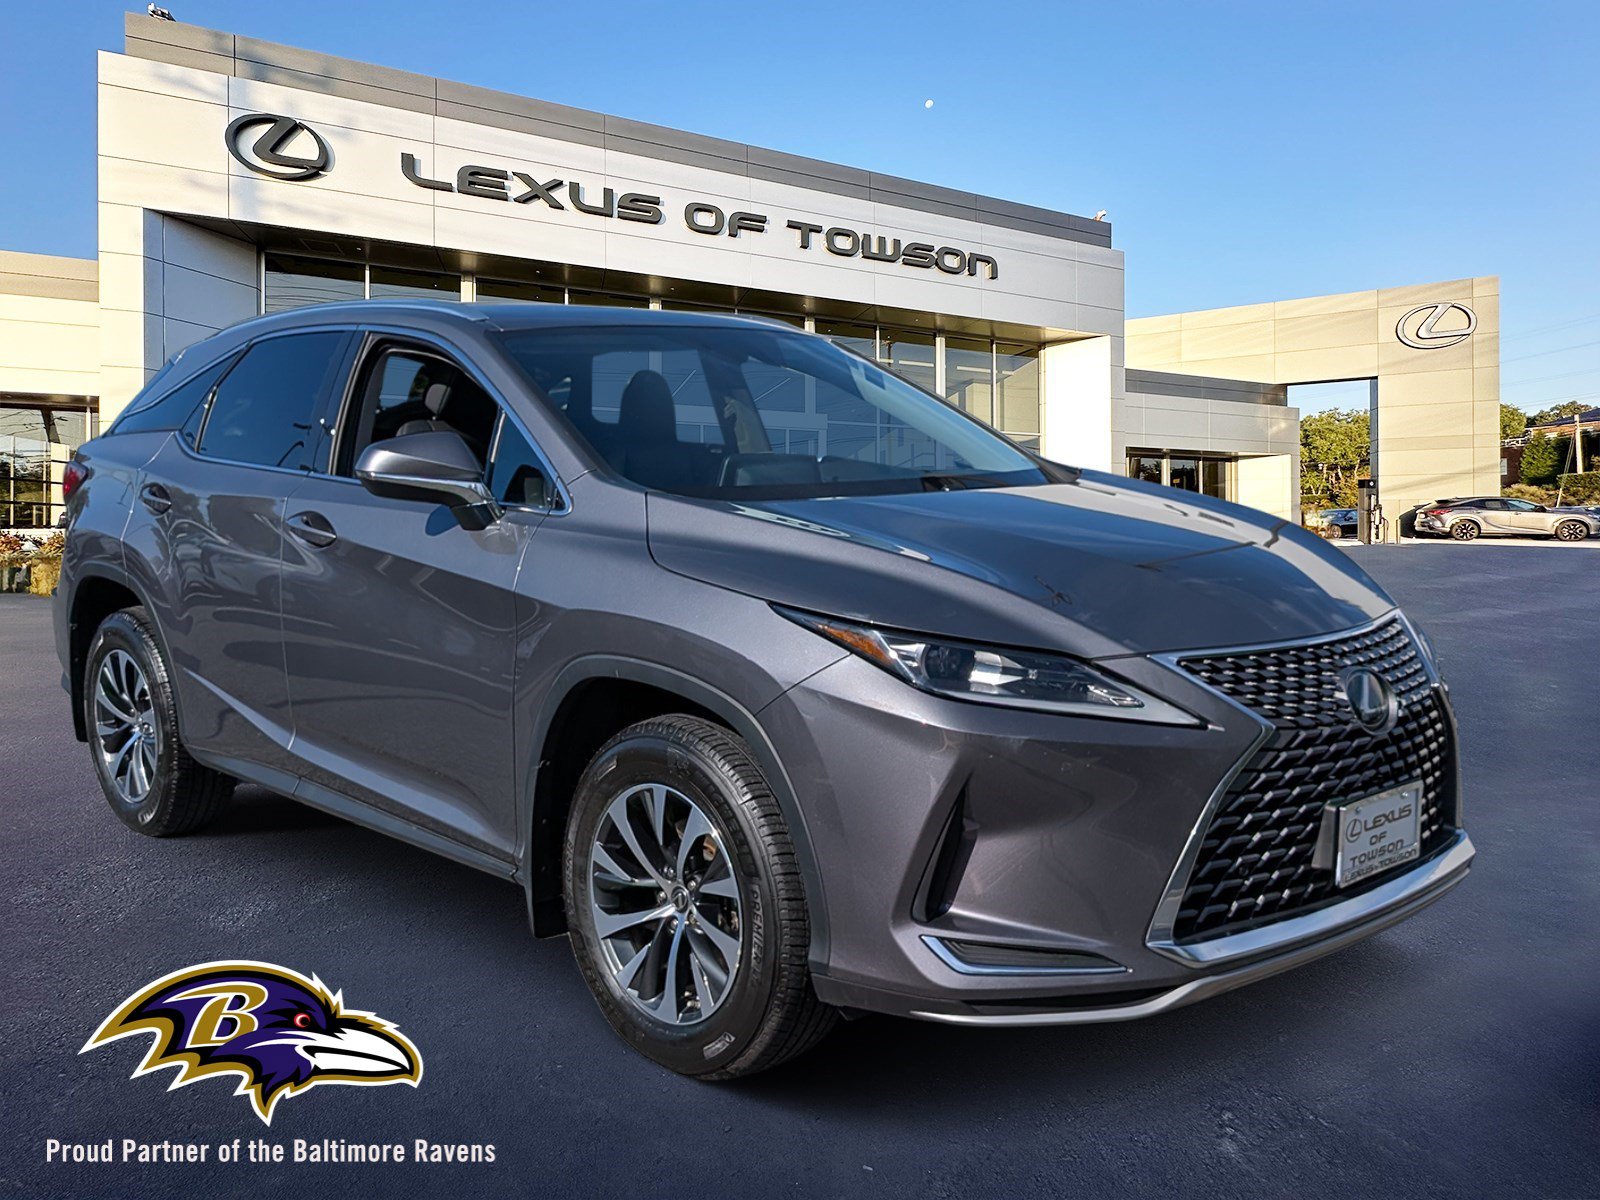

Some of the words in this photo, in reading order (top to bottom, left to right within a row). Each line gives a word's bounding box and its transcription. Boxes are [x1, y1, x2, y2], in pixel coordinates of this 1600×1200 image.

[401, 153, 662, 225] LEXUS
[684, 202, 766, 238] OF
[786, 219, 999, 279] TOWSON
[1364, 804, 1412, 832] LEXUS
[1369, 831, 1387, 846] OF
[1350, 839, 1404, 868] TOWSON
